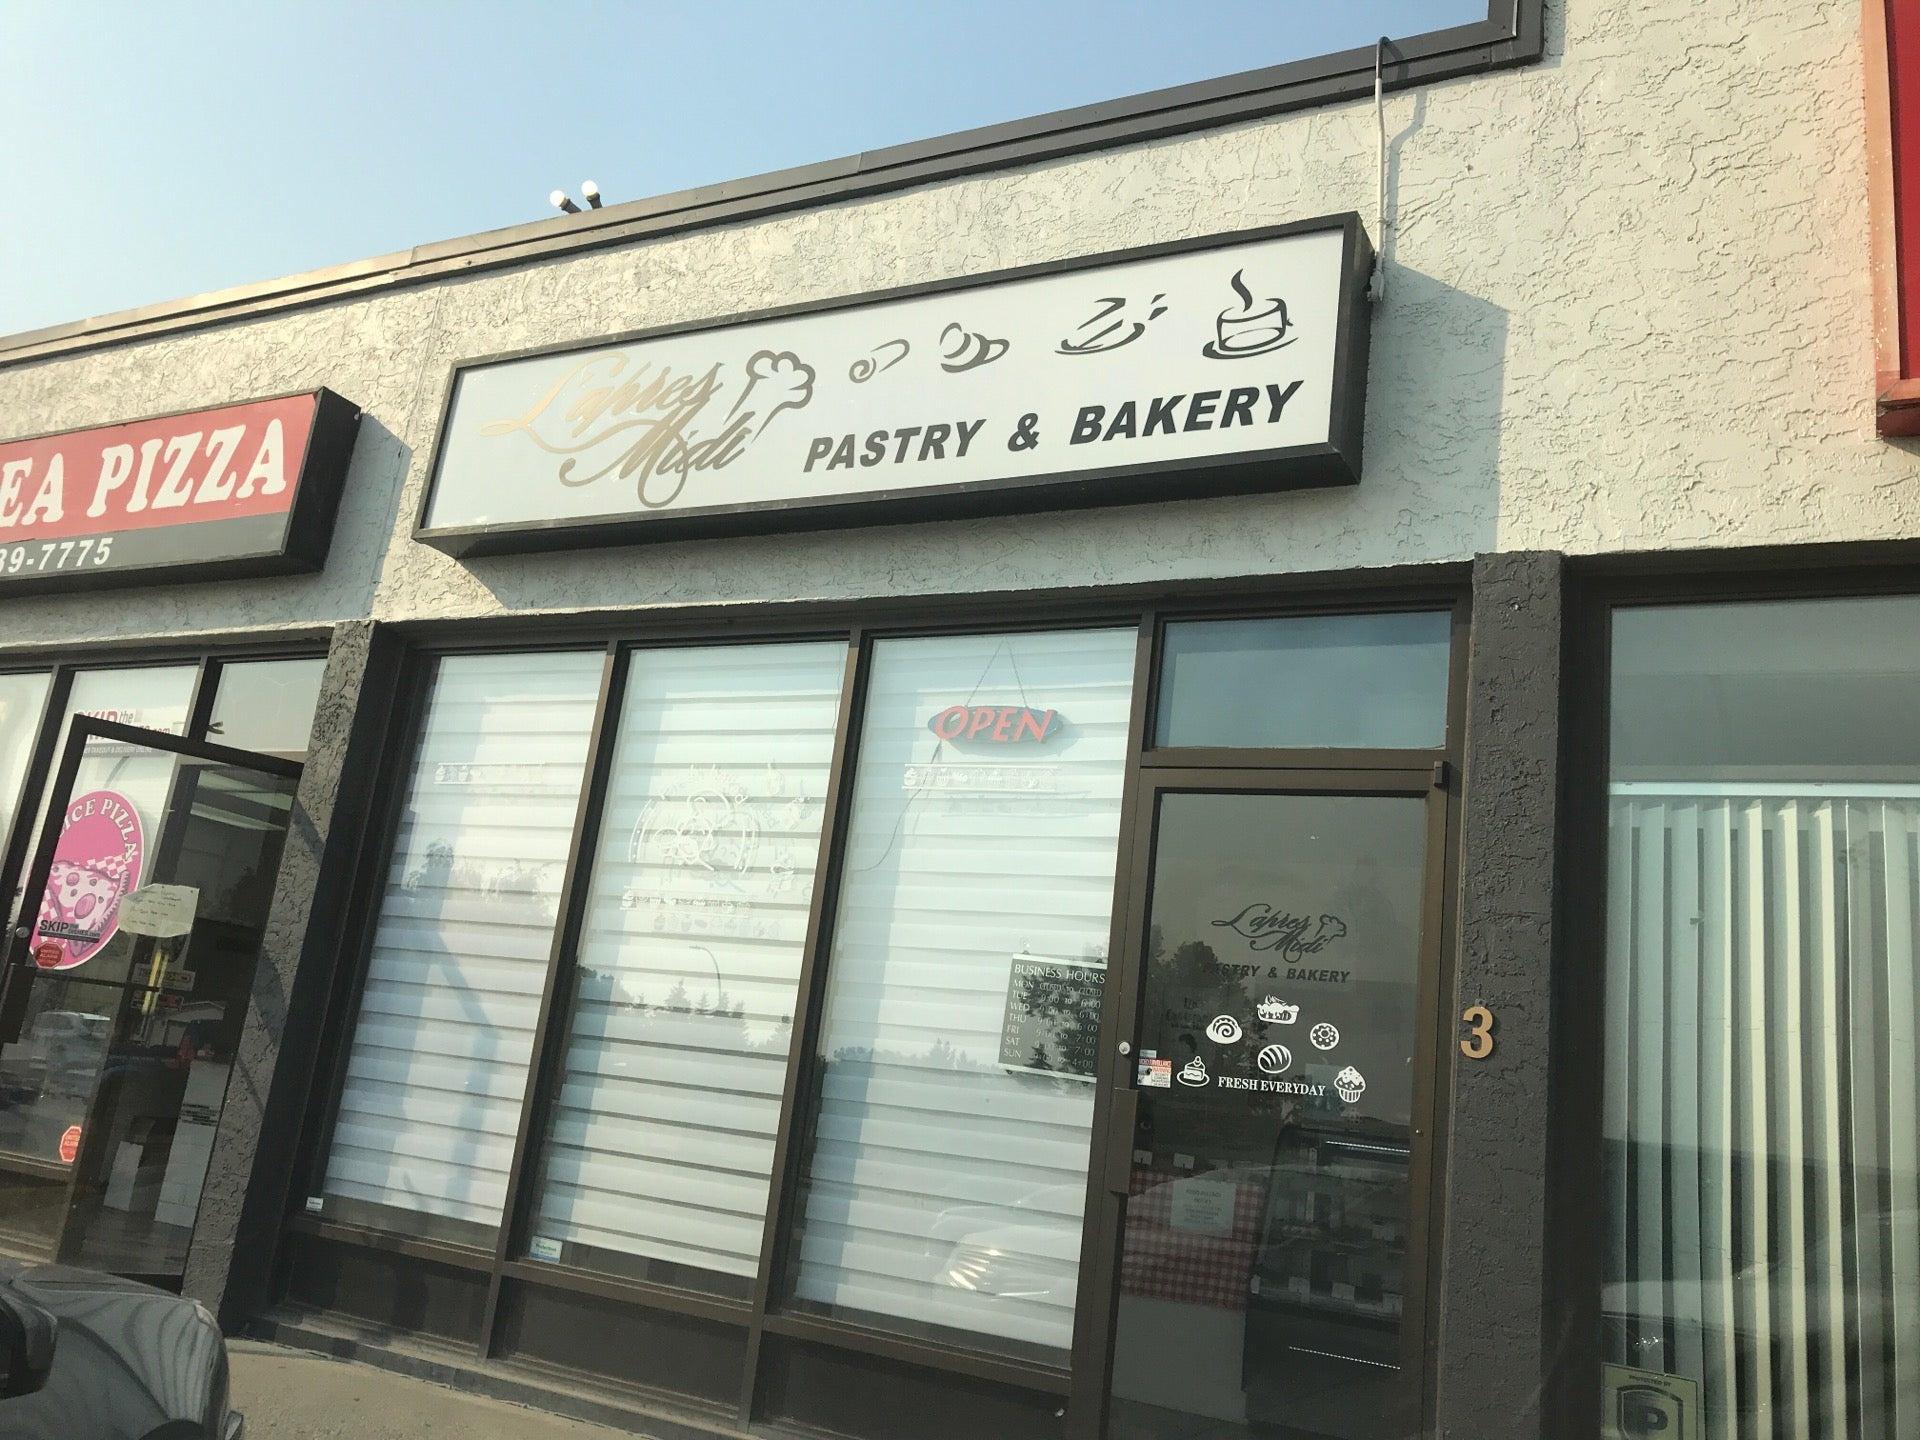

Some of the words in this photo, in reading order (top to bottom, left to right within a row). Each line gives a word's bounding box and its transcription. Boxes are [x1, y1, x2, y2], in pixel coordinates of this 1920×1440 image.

[802, 418, 986, 473] PASTRY
[1007, 412, 1040, 452] &
[1069, 379, 1305, 446] BAKERY
[87, 417, 287, 518] PIZZA
[934, 705, 1059, 743] OPEN
[59, 799, 96, 838] ICE
[100, 798, 136, 861] PIZZA
[40, 919, 69, 933] SKIP
[1014, 963, 1062, 979] BUSINESS
[1066, 969, 1106, 984] HOURS
[1267, 966, 1278, 979] &
[1286, 968, 1351, 984] BAKERY
[1012, 990, 1028, 1000] TUE
[1010, 1001, 1030, 1012] WED
[1009, 1012, 1027, 1023] THU
[1006, 1023, 1020, 1034] FRI
[1460, 1006, 1494, 1059] 3
[1004, 1036, 1021, 1046] SAT
[1003, 1048, 1022, 1059] SUN
[1217, 1075, 1258, 1091] FRESH
[1260, 1079, 1326, 1096] EVERYDAY
